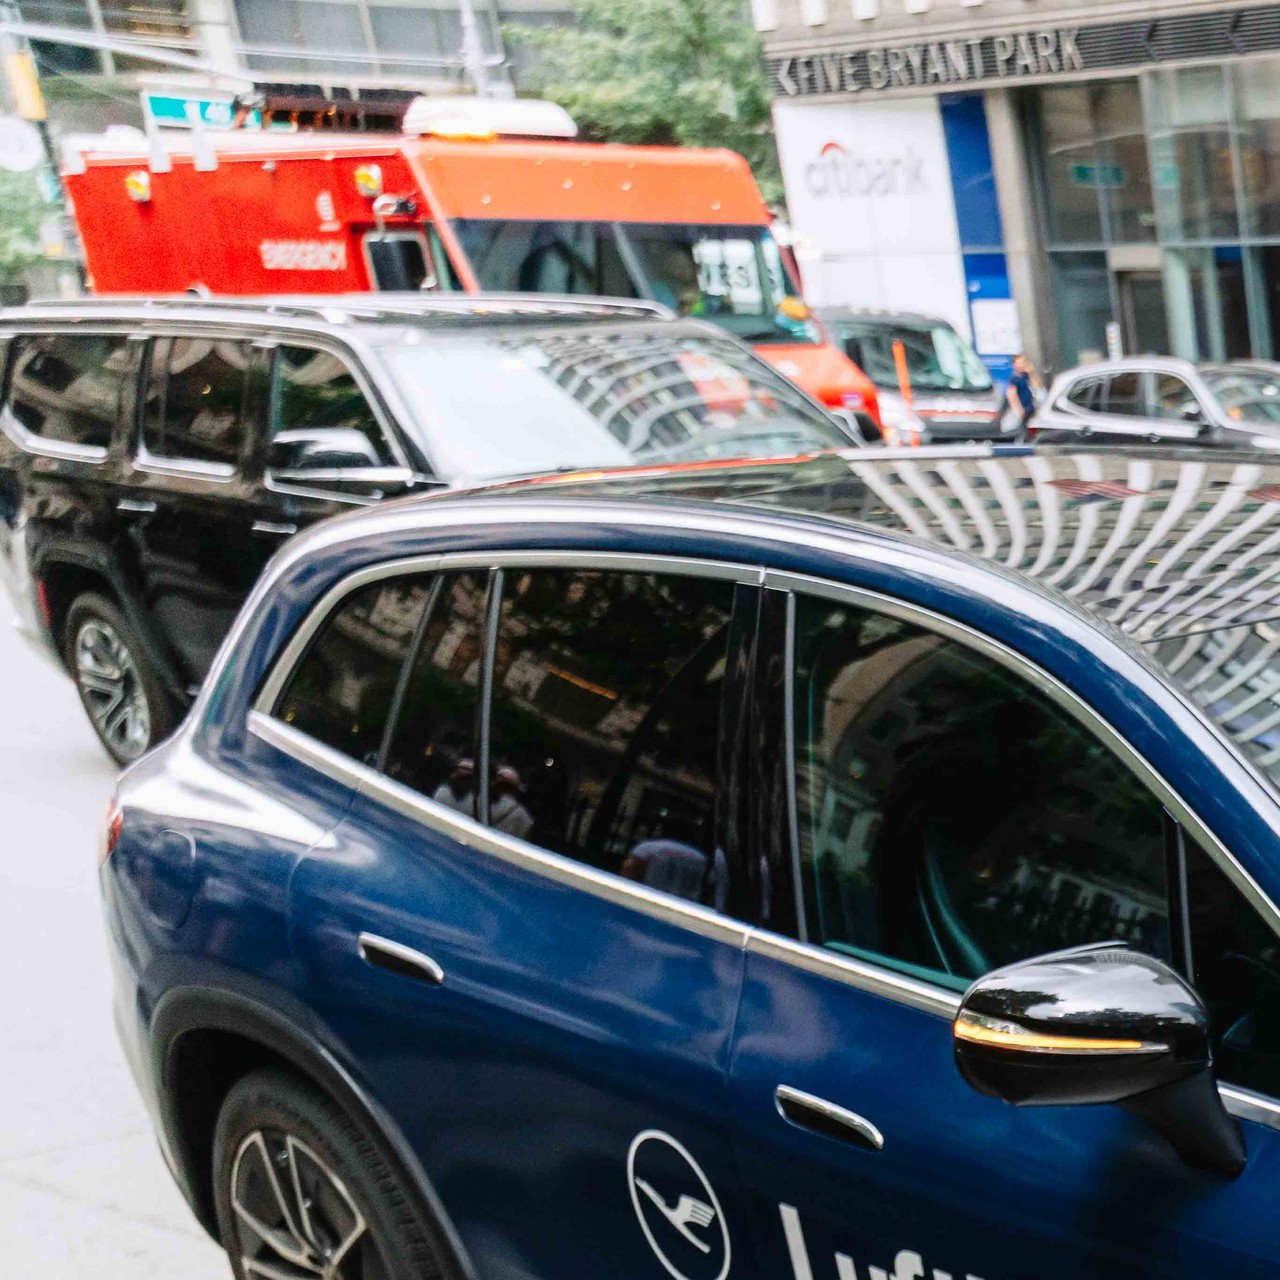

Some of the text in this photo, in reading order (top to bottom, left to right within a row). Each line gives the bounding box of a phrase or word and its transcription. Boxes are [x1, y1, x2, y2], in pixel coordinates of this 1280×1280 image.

[798, 27, 1084, 93] FIVE BRYANT PARK
[802, 144, 927, 198] citibank
